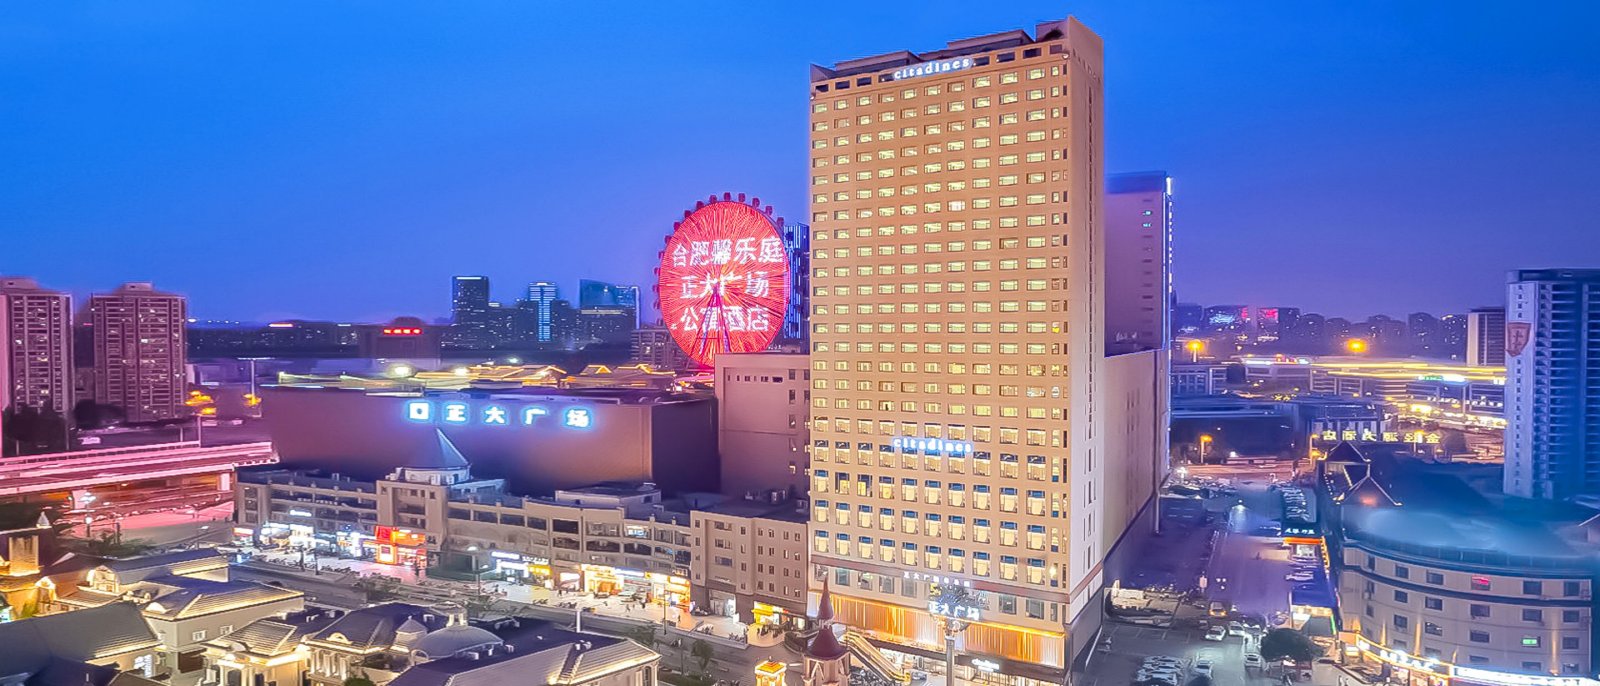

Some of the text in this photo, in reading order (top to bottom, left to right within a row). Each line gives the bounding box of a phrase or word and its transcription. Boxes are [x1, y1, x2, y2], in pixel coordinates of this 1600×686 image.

[894, 58, 970, 79] citadines
[672, 236, 784, 267] 合肥馨乐庭
[680, 271, 769, 299] 正大广场
[680, 304, 769, 332] 公寓酒店
[446, 404, 590, 428] 正大广场
[893, 438, 972, 453] citadines
